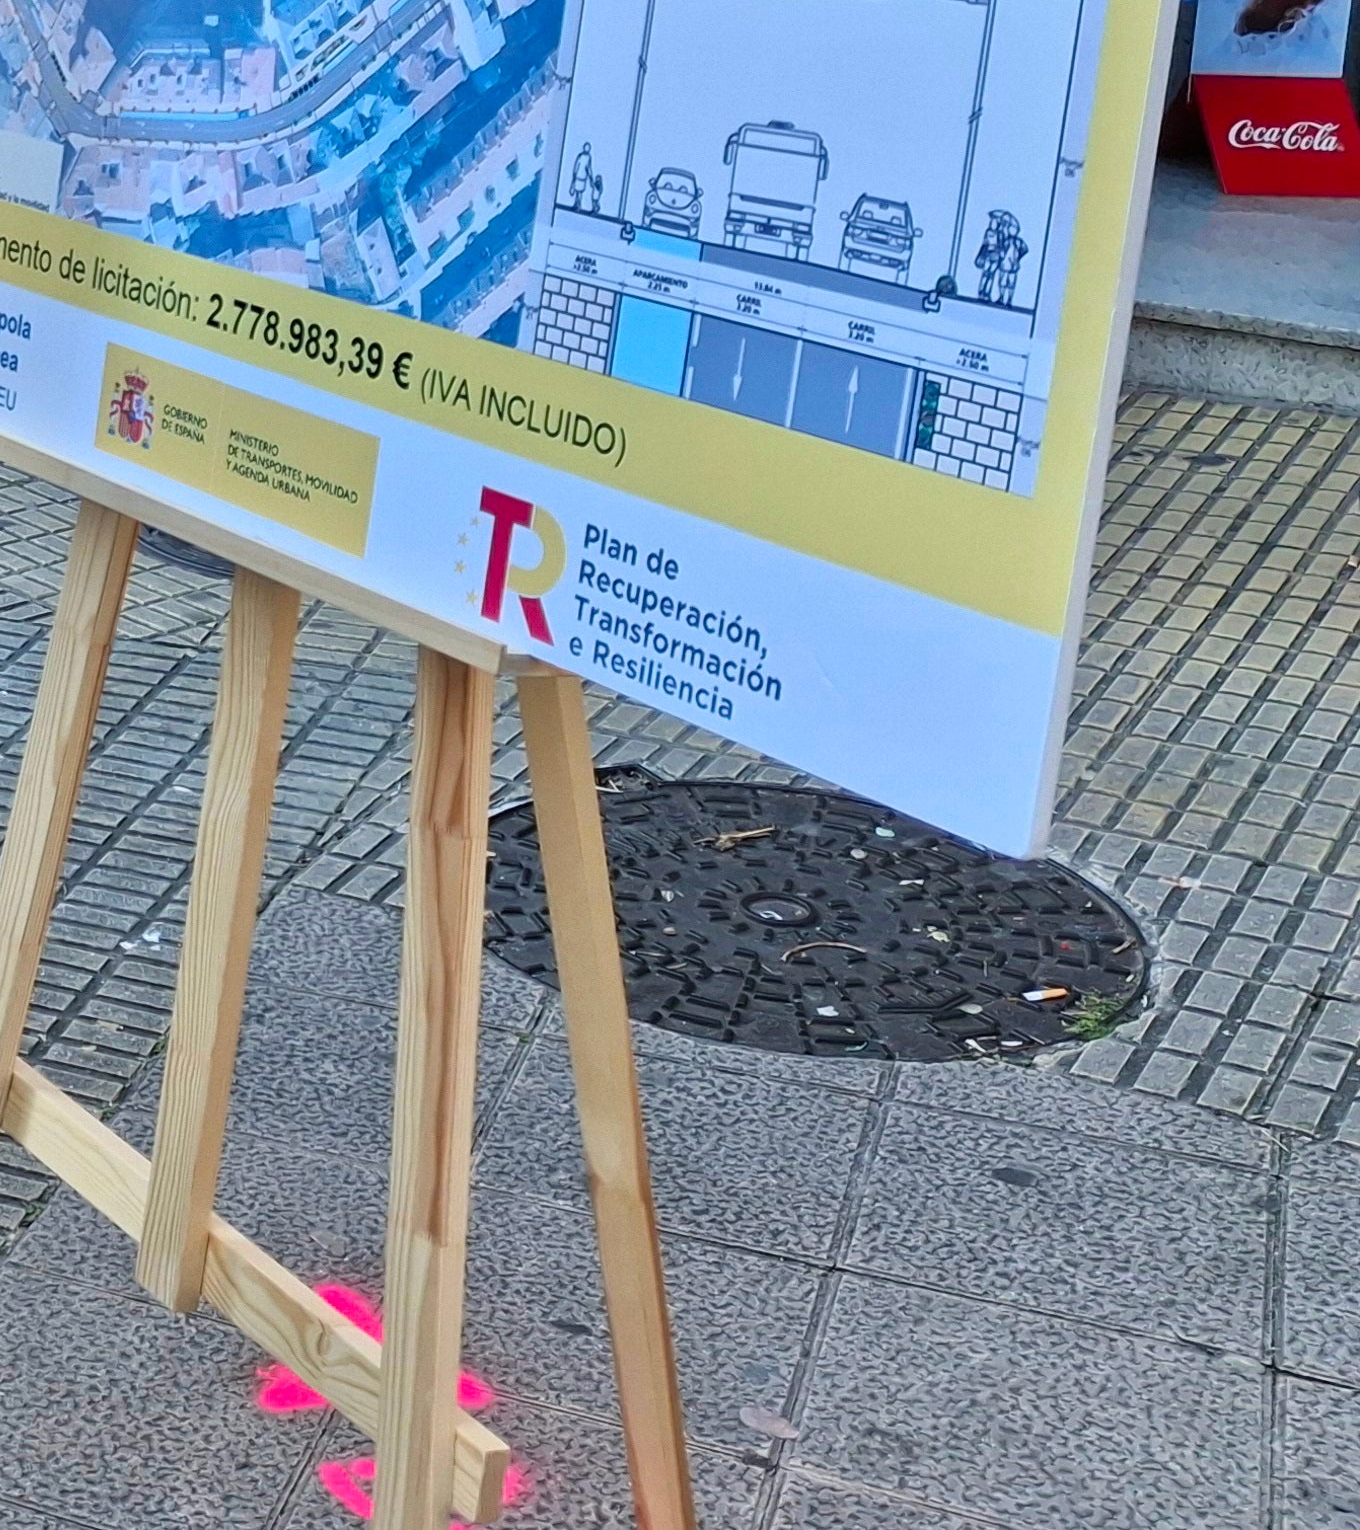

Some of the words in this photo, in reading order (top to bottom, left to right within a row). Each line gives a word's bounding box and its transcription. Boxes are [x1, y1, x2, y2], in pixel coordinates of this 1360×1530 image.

[632, 269, 688, 289] APARCAMIENTO
[59, 249, 86, 284] de
[92, 257, 199, 322] licitación:
[206, 293, 383, 379] 2.778.983,39
[392, 351, 414, 389] €
[421, 367, 472, 410] (IVA
[480, 384, 628, 469] INCLUIDO)
[161, 418, 173, 432] DE
[174, 422, 205, 445] ESPAÑA
[163, 403, 208, 430] GOBIERNO
[229, 429, 279, 457] MINISTERIO
[226, 458, 232, 470] Y
[232, 462, 270, 485] AGENDA
[272, 477, 311, 502] URBANA
[228, 444, 239, 458] DE
[240, 449, 304, 484] TRANSPORTES,
[305, 473, 358, 504] MOVILIDAD
[583, 522, 637, 566] Plan
[646, 547, 680, 581] de
[578, 558, 768, 660] Recuperación,
[574, 594, 782, 701] Transformación
[569, 634, 584, 657] e
[593, 639, 734, 721] Resiliencia
